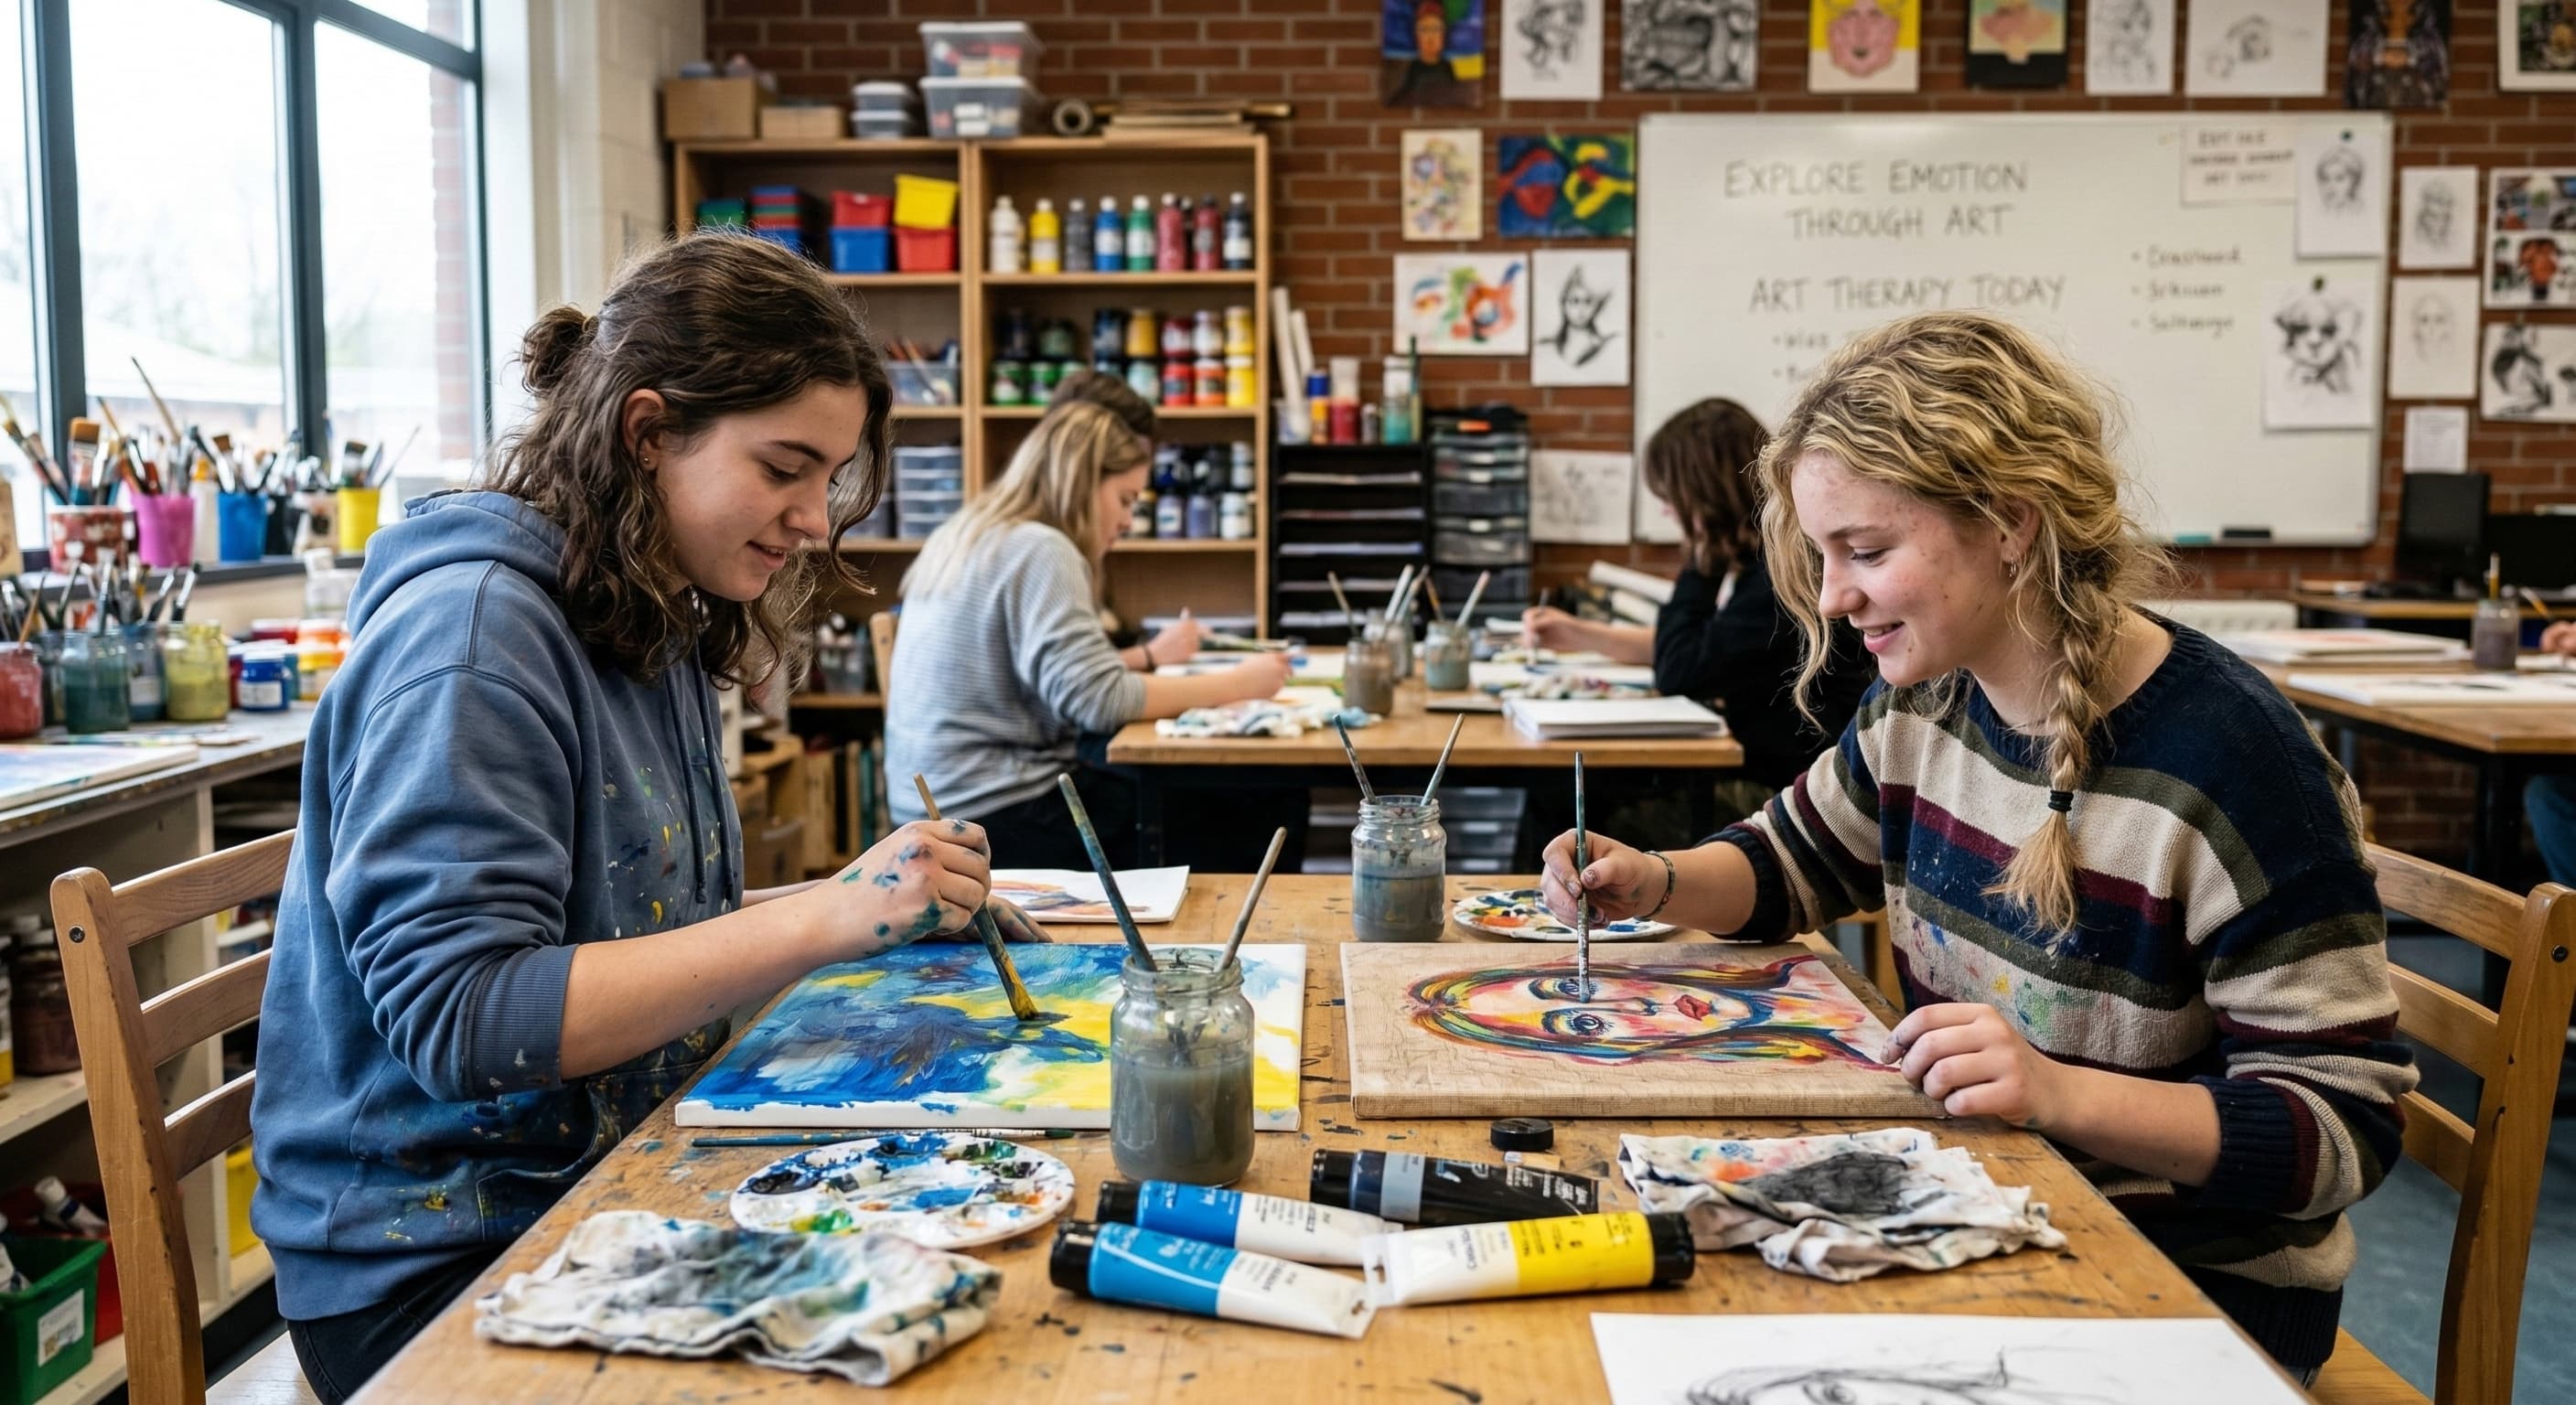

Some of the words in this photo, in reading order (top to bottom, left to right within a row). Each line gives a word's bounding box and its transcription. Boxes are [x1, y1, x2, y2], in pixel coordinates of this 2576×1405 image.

[1724, 159, 1867, 198] EXPLORE
[1888, 159, 2028, 194] EMOTION
[1785, 206, 1924, 240] THROUGH
[1945, 203, 2014, 237] ART
[1748, 277, 1811, 314] ART
[1825, 276, 1956, 310] THERAPY
[1970, 273, 2066, 312] TODAY
